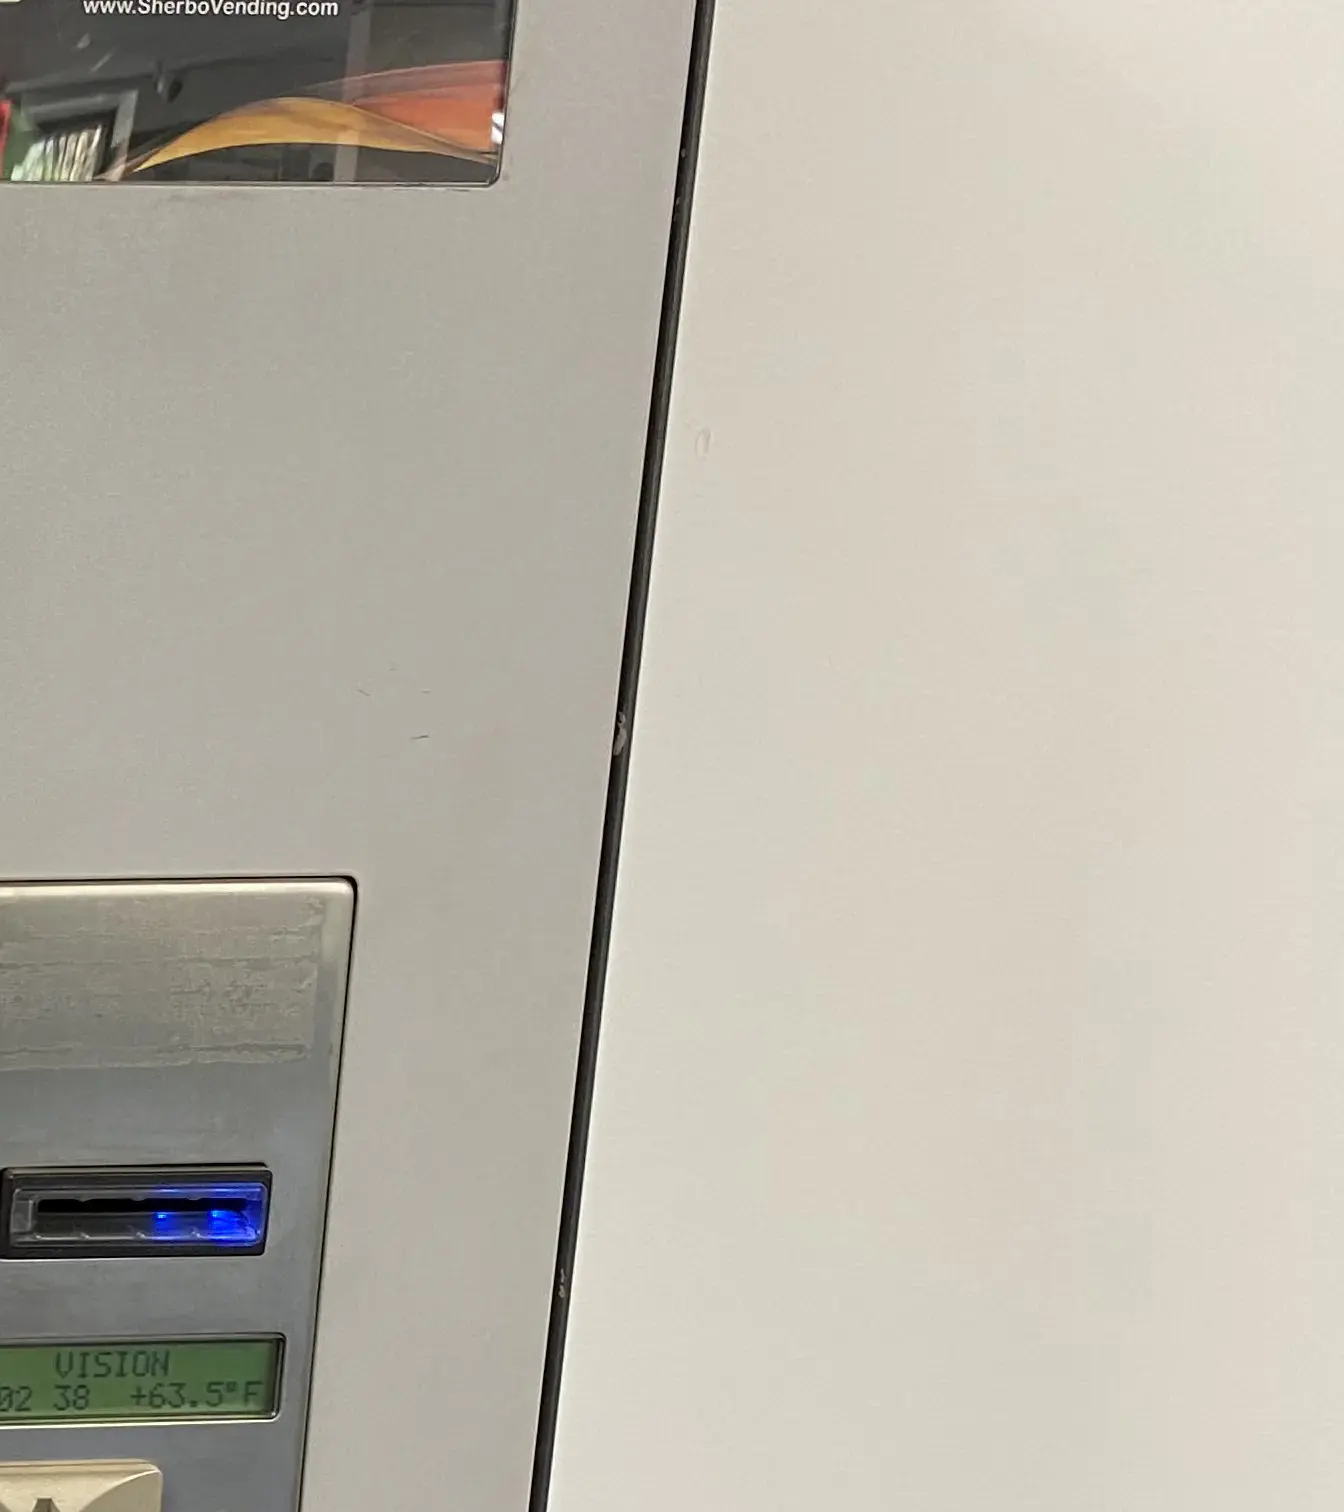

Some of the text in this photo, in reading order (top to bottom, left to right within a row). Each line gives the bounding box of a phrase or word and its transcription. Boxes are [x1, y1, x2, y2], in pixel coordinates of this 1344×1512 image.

[83, 0, 339, 20] www.SherboVending.com
[54, 1351, 170, 1378] VISION
[53, 1384, 90, 1411] 38
